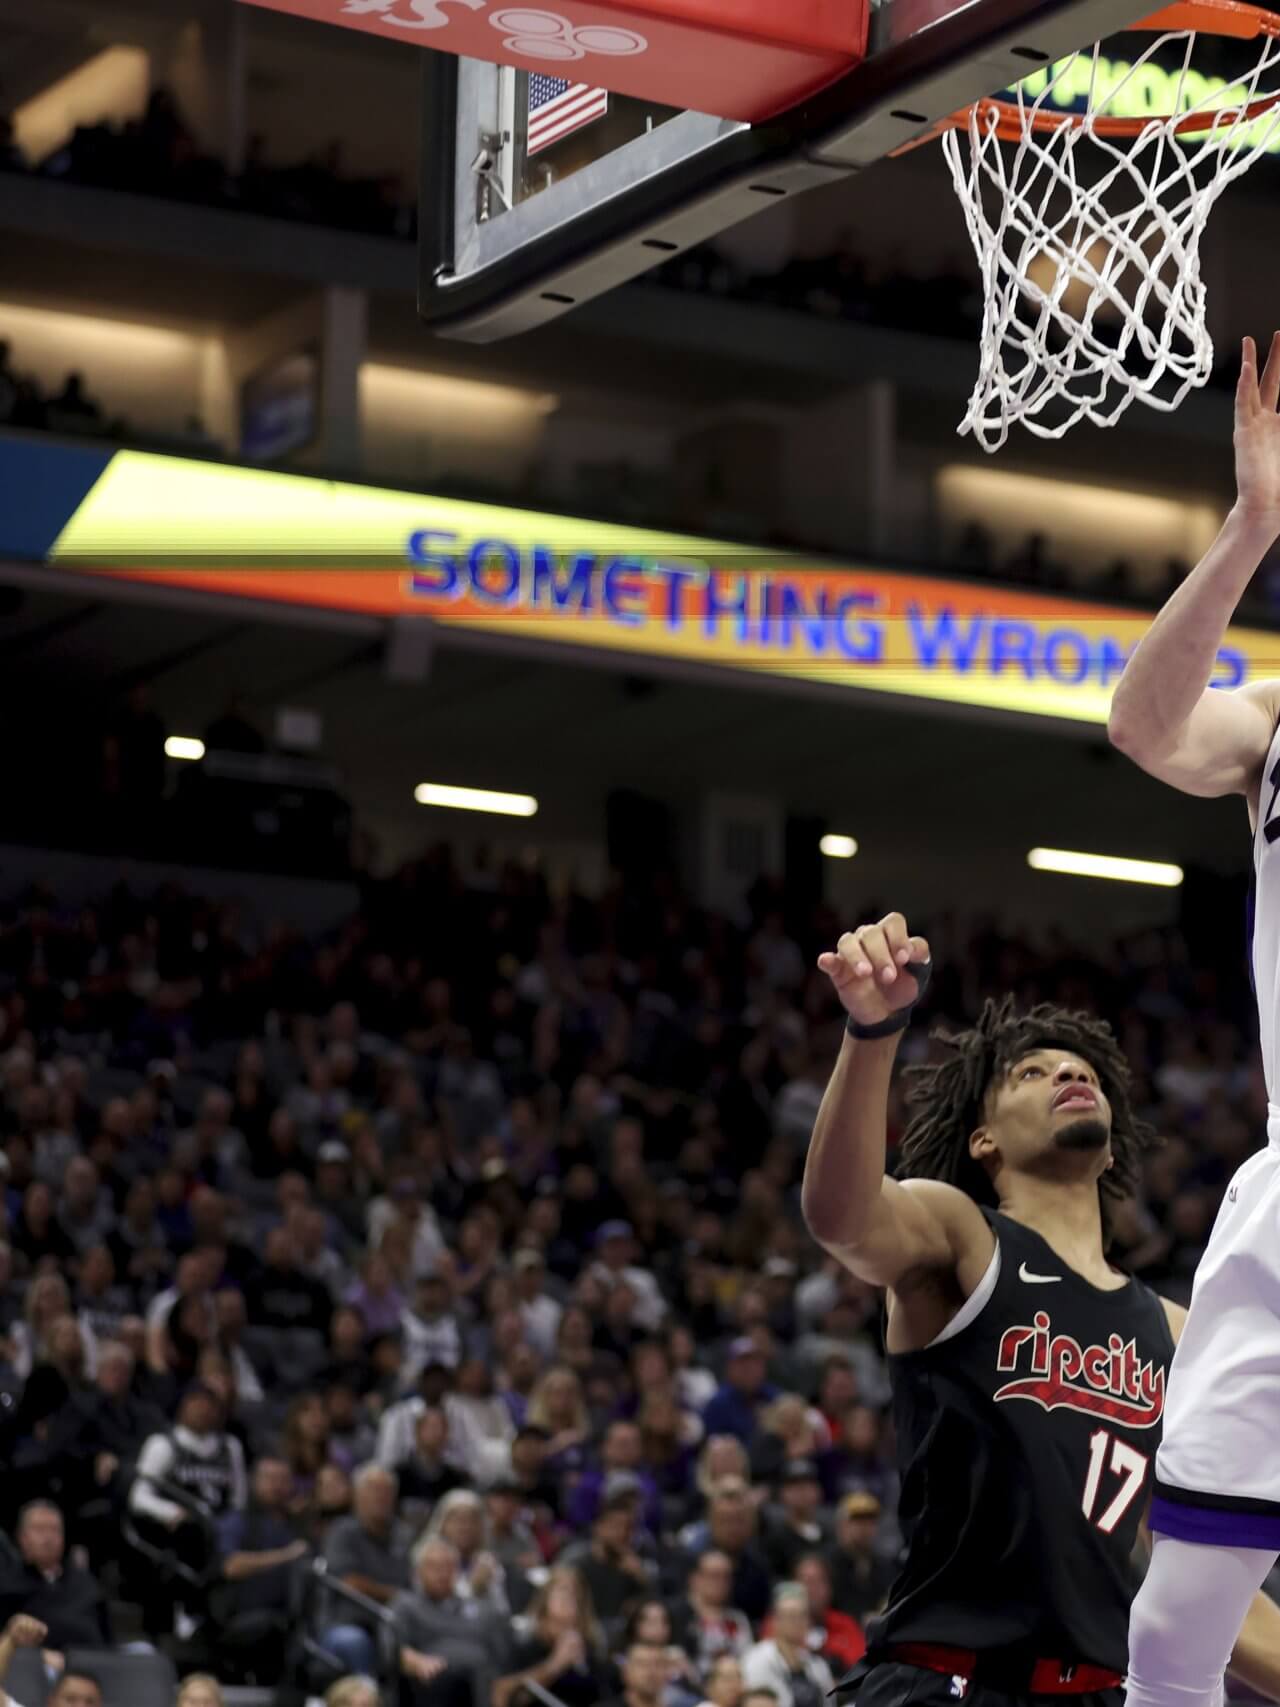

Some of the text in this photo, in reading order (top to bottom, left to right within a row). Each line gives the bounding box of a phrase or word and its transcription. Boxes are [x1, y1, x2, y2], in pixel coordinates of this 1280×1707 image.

[408, 528, 884, 664] SOMETHING
[993, 1310, 1165, 1429] ripcity
[1081, 1427, 1148, 1536] 17
